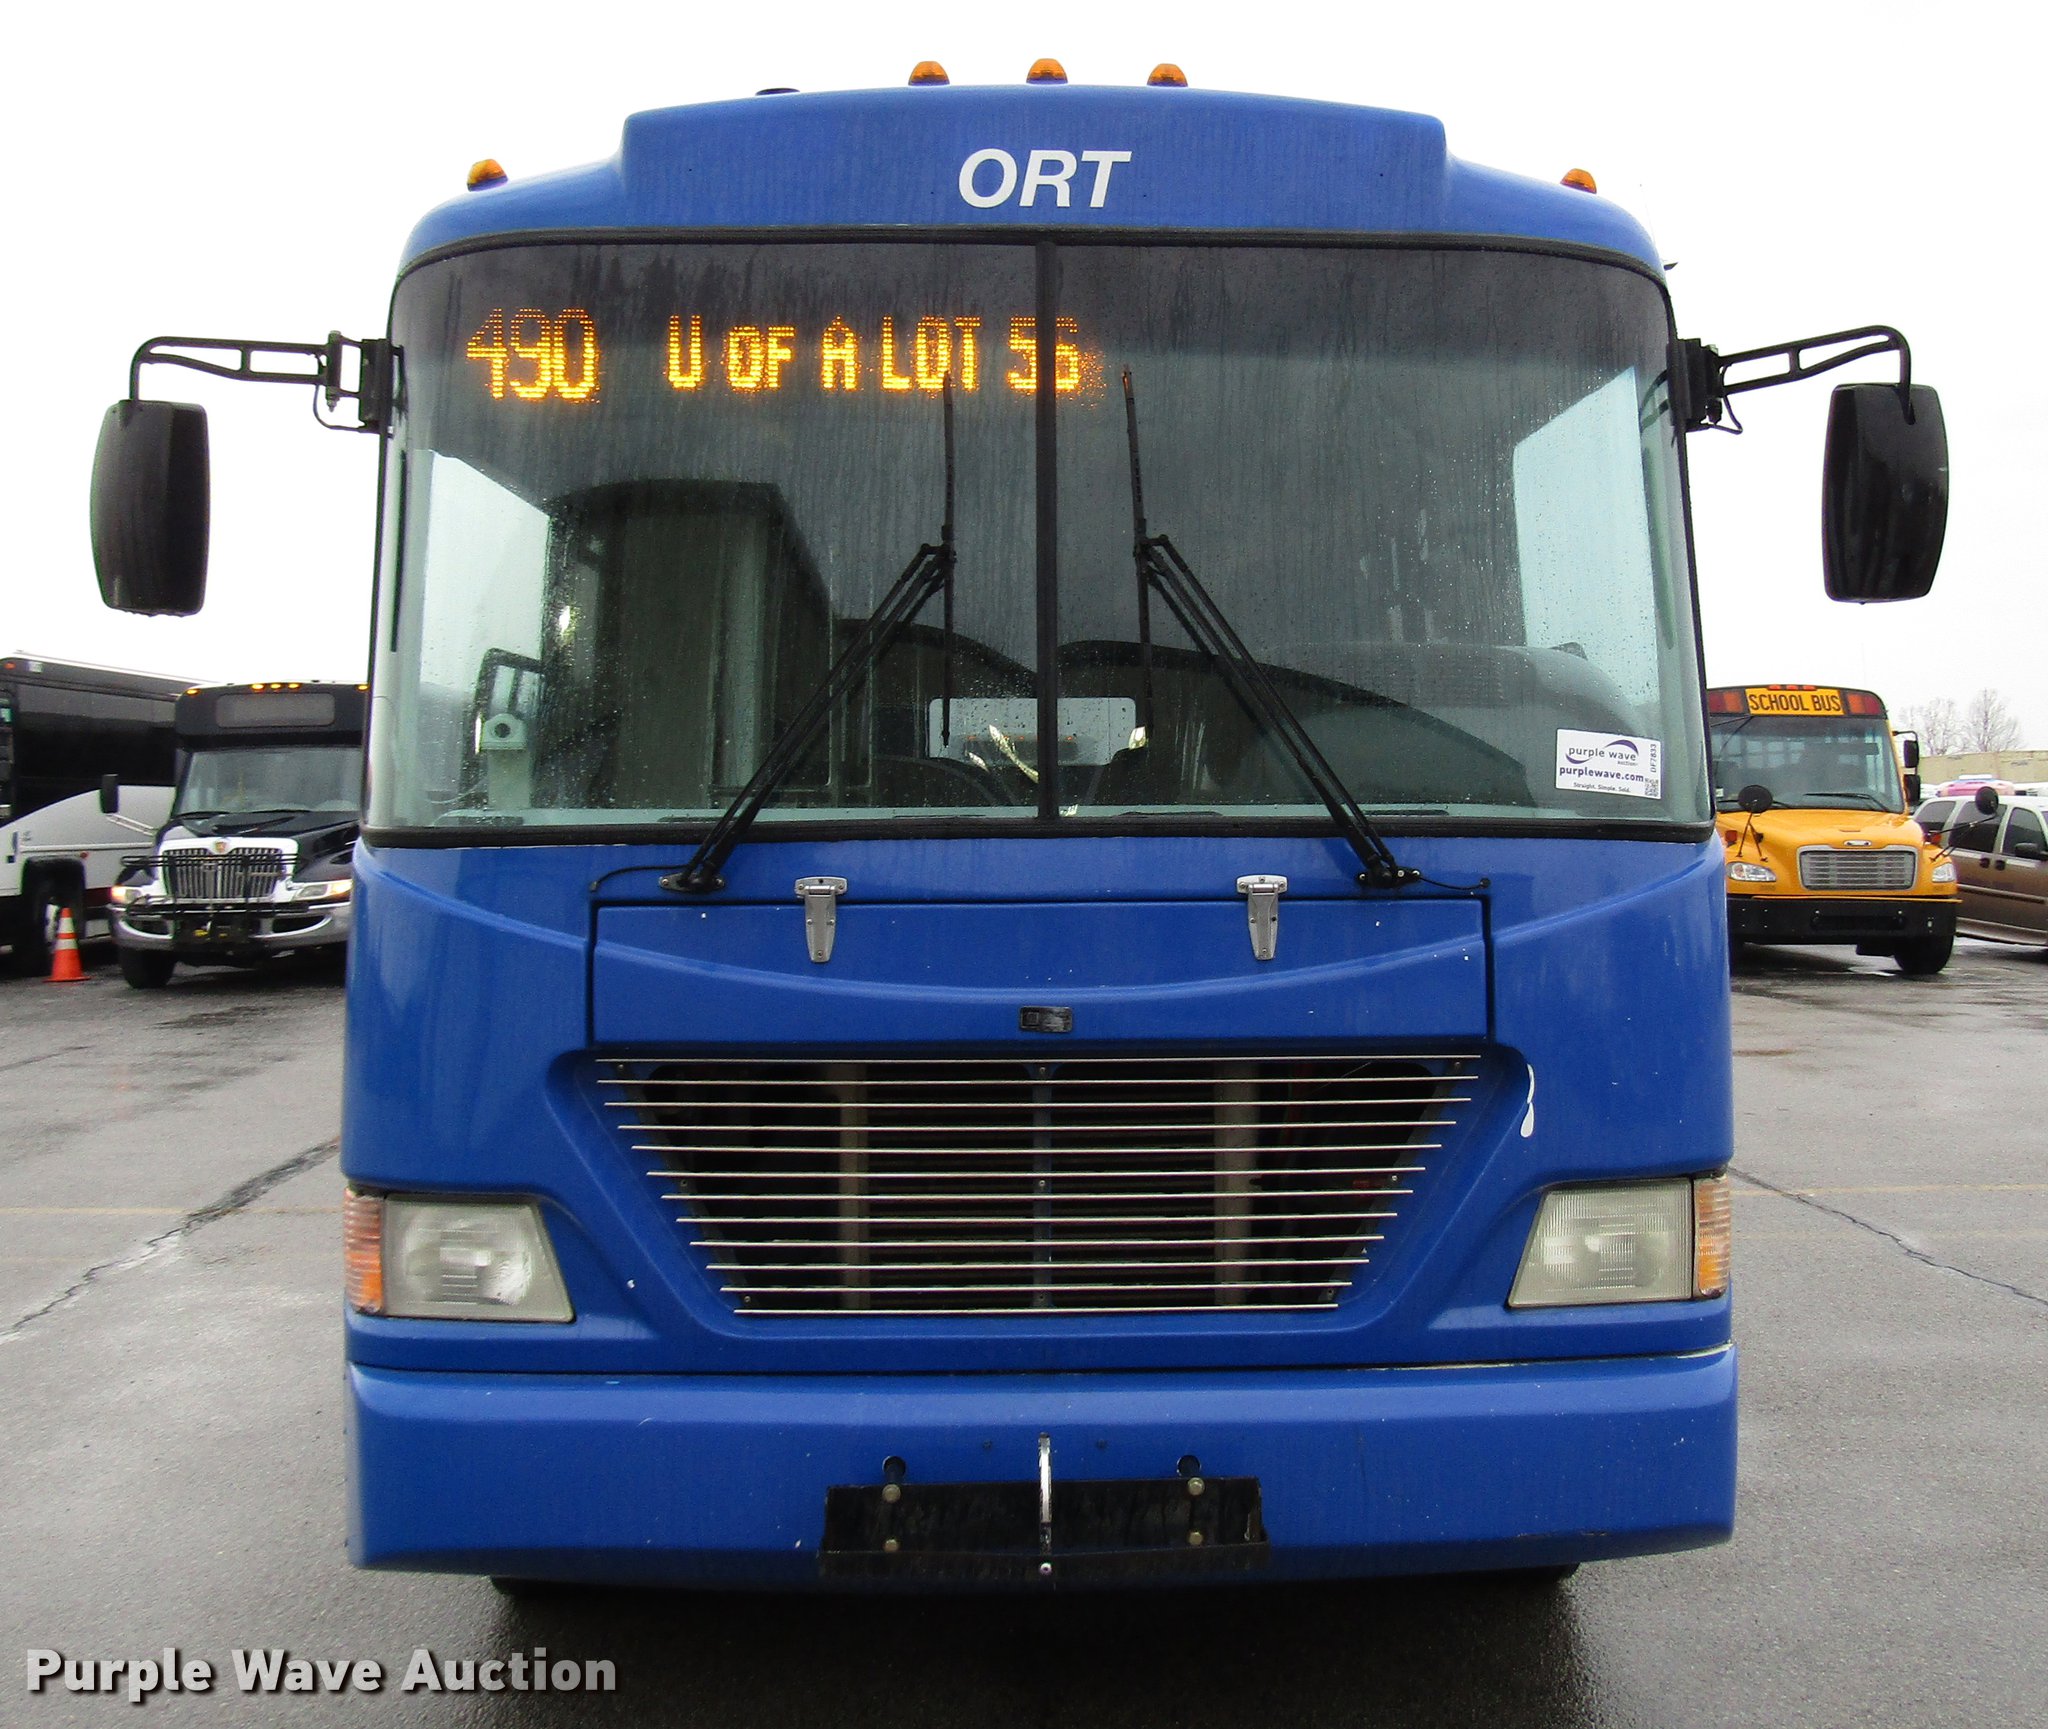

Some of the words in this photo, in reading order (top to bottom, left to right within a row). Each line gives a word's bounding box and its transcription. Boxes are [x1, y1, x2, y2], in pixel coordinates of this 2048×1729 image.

[958, 148, 1132, 208] ORT
[466, 308, 595, 399] 490
[668, 314, 702, 389] U
[727, 325, 795, 389] OF
[822, 314, 857, 390] A
[881, 314, 981, 390] LOT
[1009, 316, 1079, 390] 56
[1748, 693, 1809, 712] SCHOOL
[1811, 694, 1842, 712] BUS
[1568, 747, 1605, 758] purple
[1608, 751, 1637, 761] wave
[1559, 766, 1644, 782] purplewave.com
